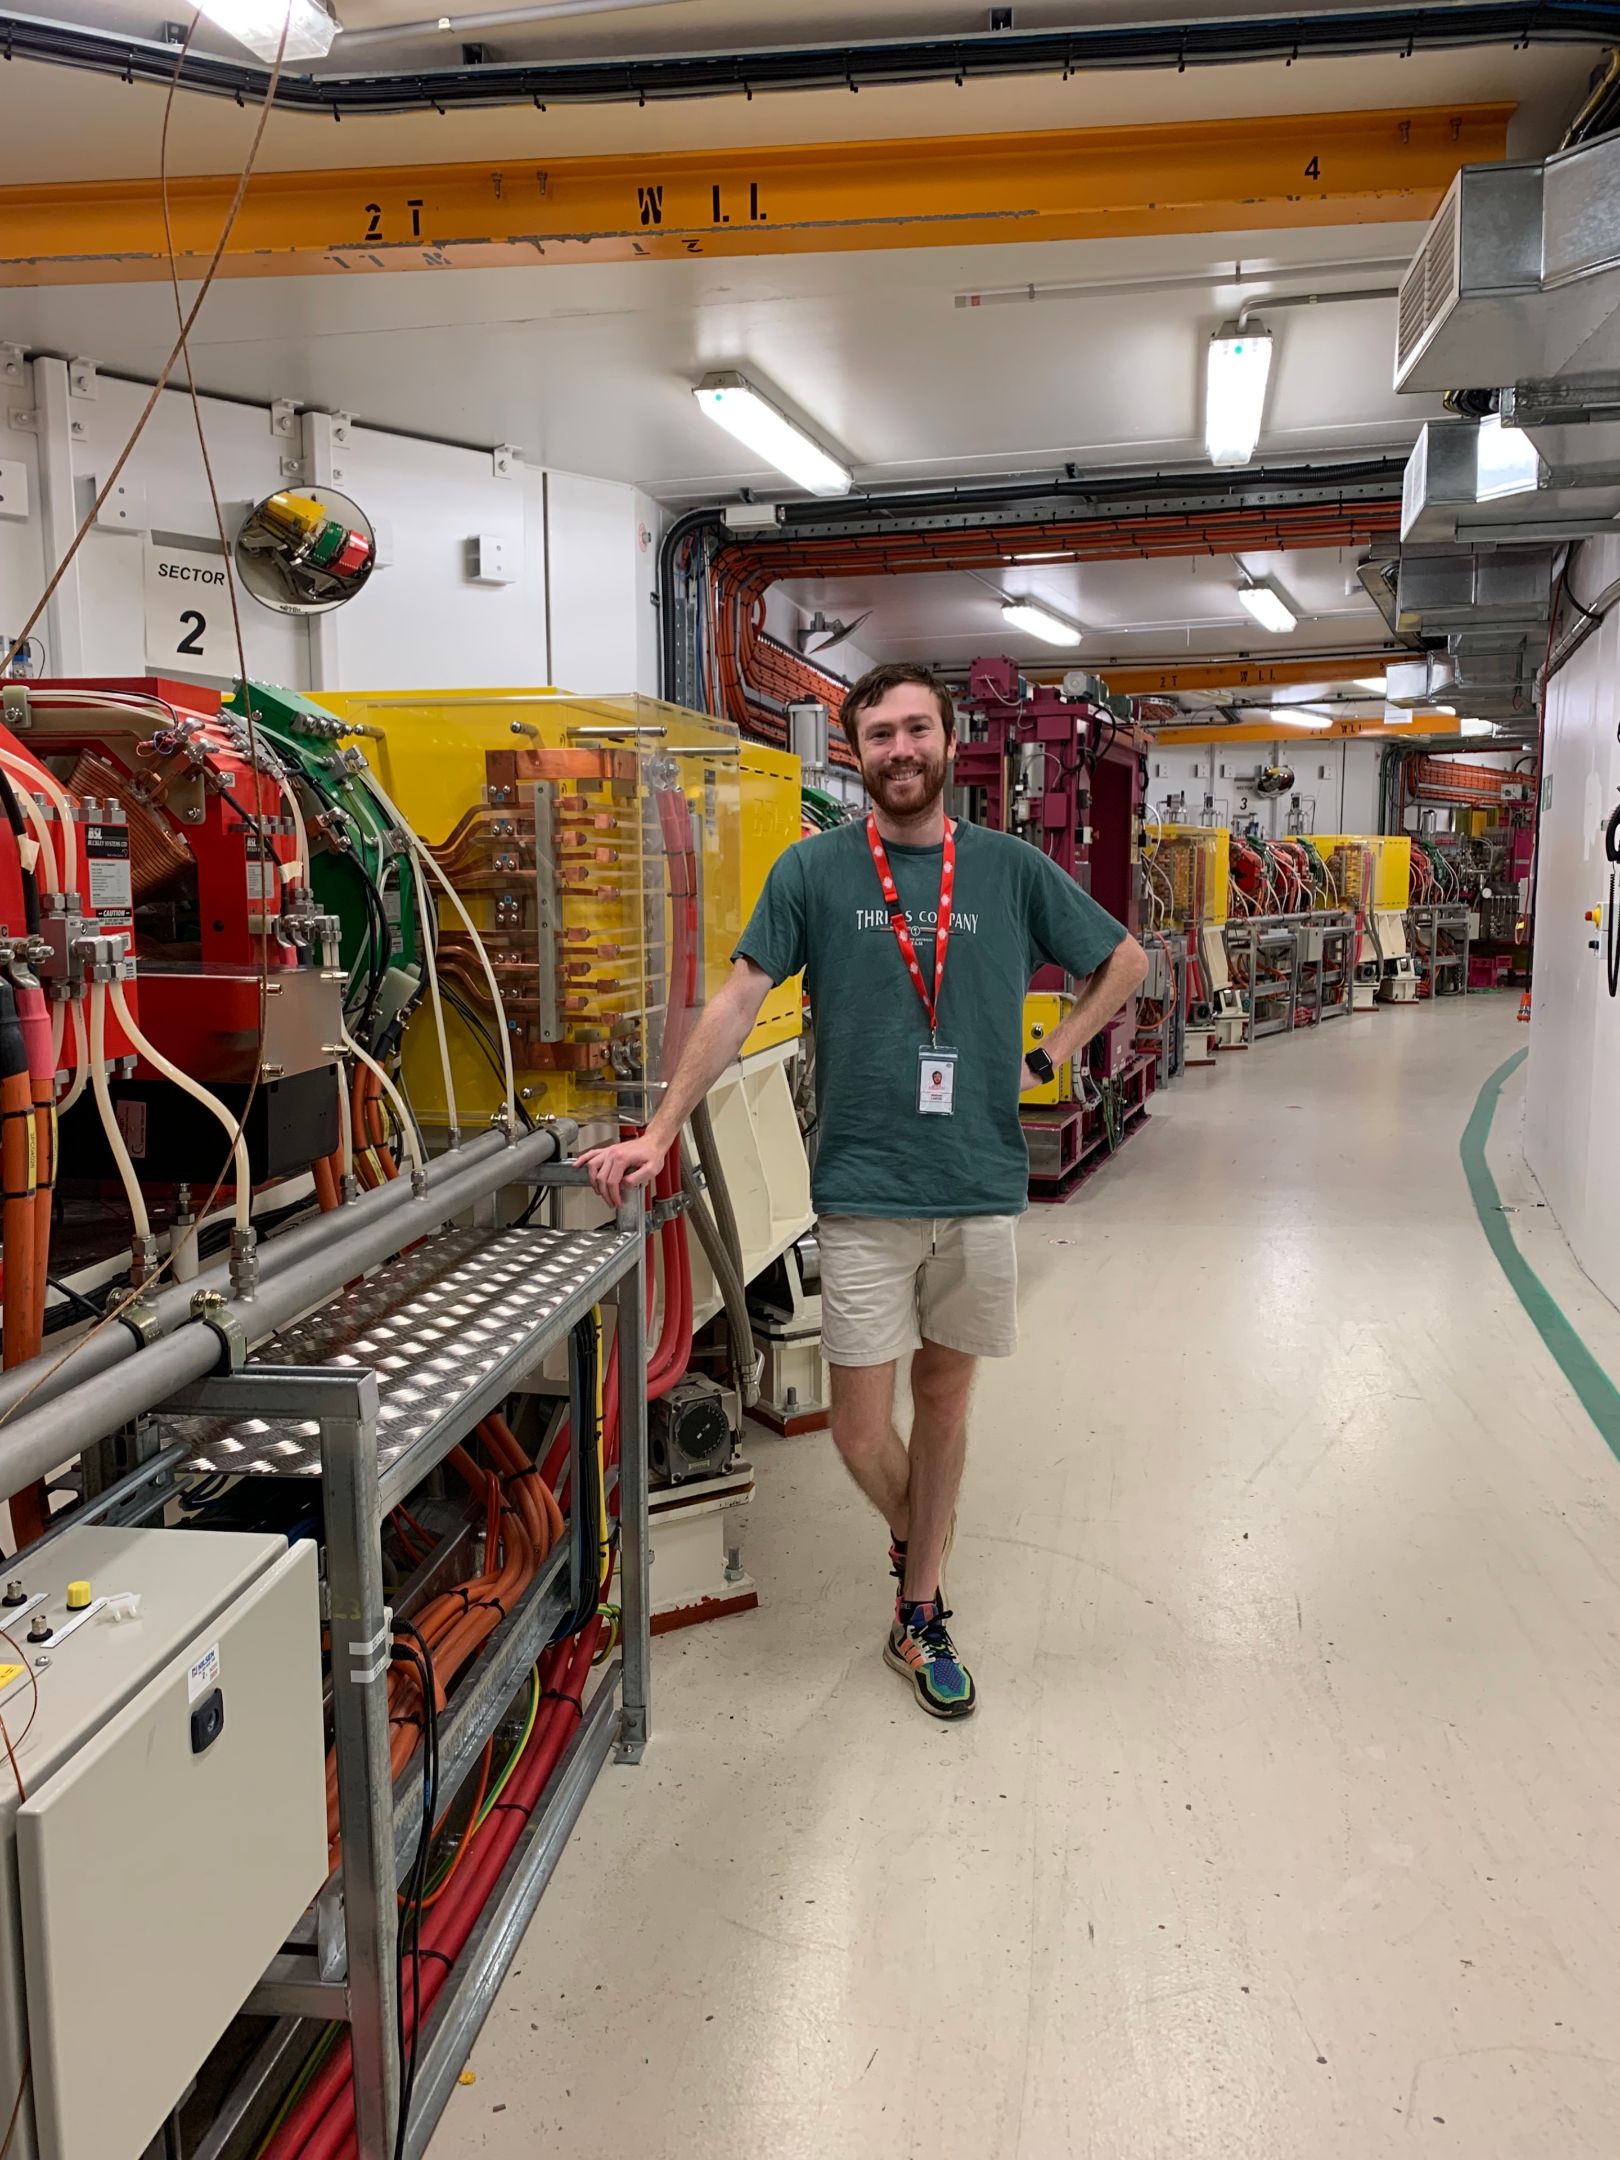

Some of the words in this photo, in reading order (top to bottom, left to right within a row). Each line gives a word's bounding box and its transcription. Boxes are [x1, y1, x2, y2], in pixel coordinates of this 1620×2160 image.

[1304, 155, 1321, 181] 4
[158, 563, 225, 586] SECTOR
[176, 609, 207, 656] 2
[1239, 797, 1248, 811] 3
[103, 909, 126, 917] CAUTION
[856, 909, 913, 931] THRIS
[918, 910, 979, 935] COPANY
